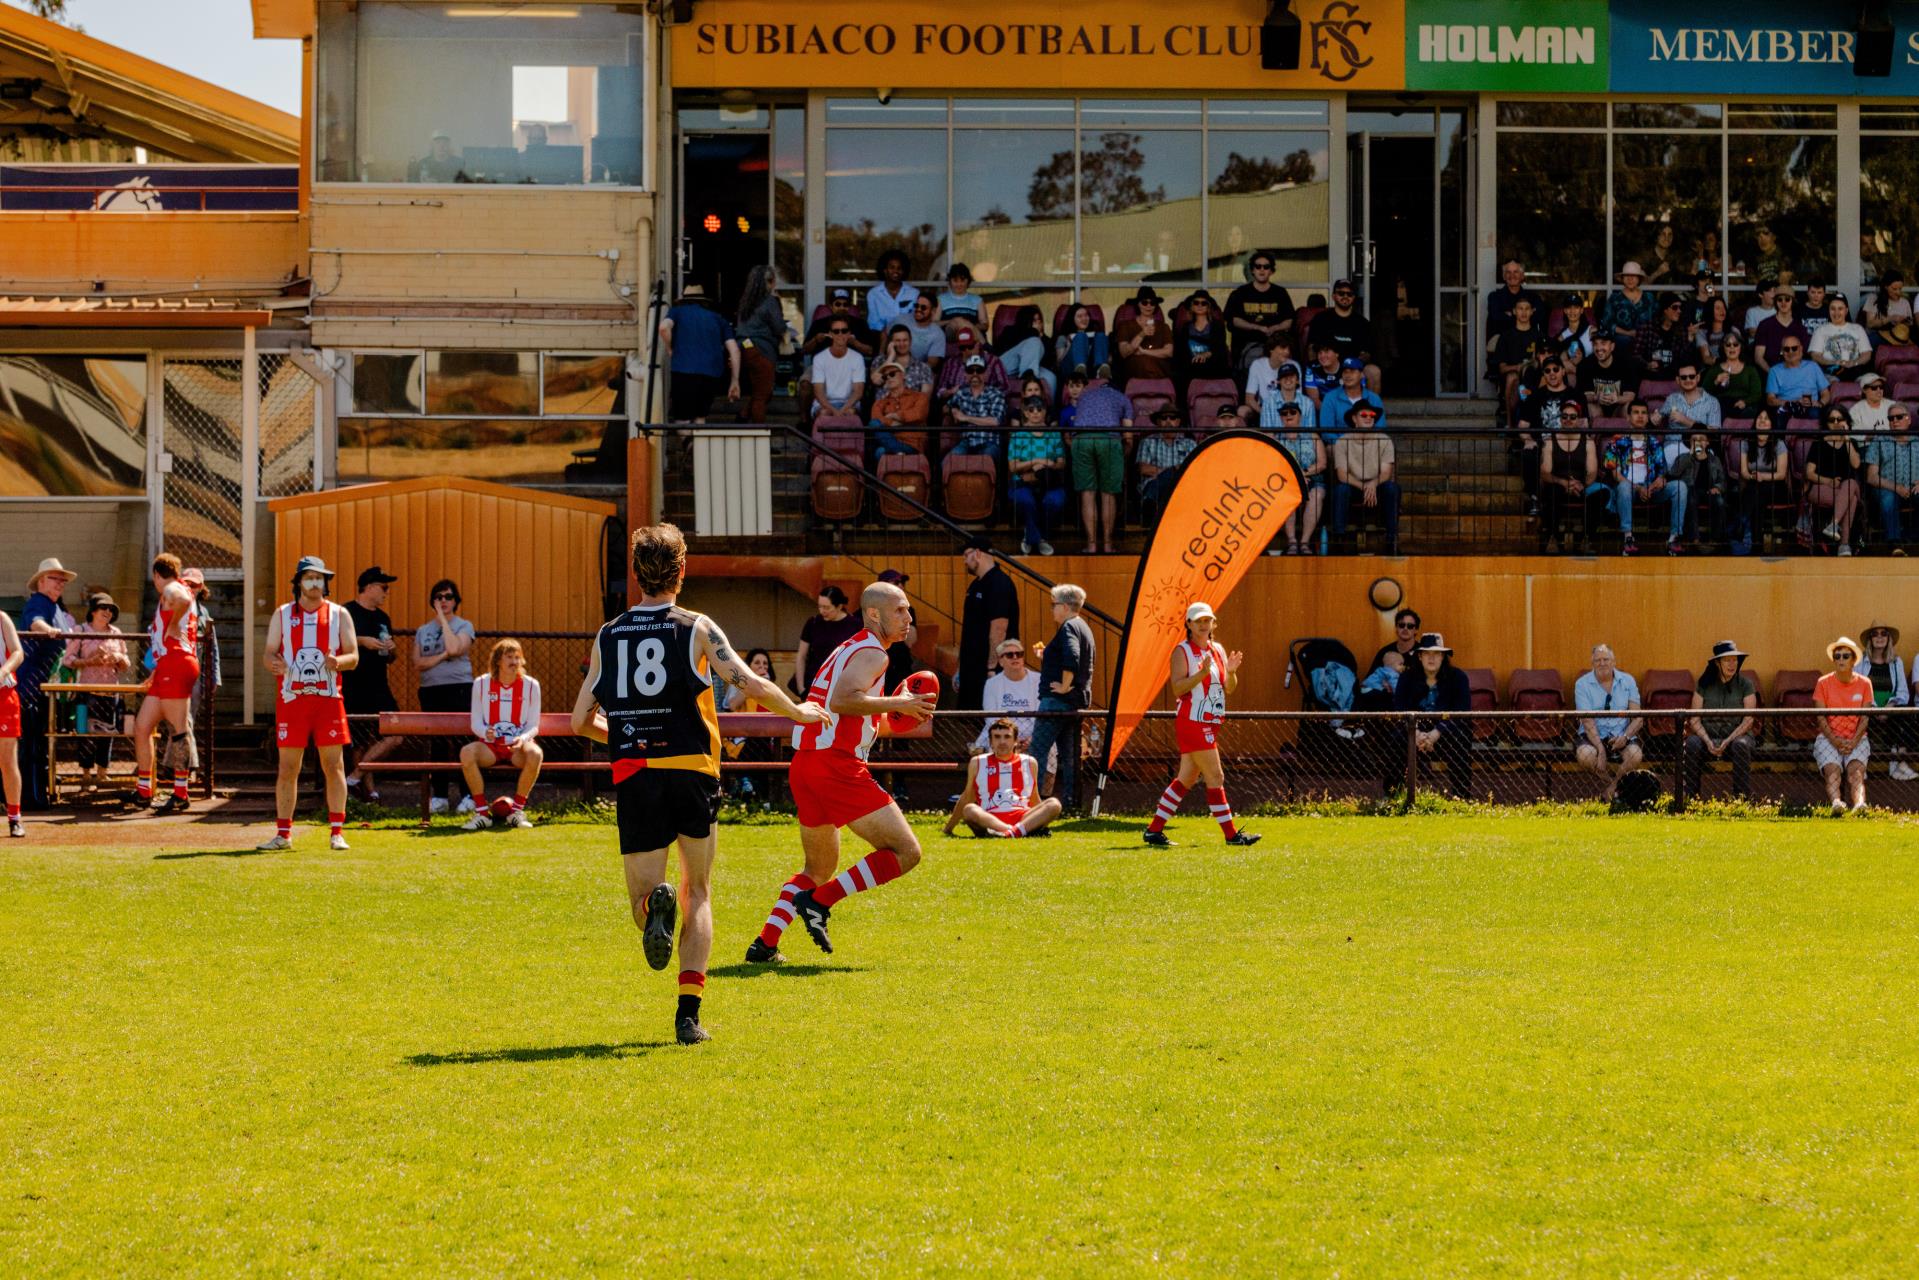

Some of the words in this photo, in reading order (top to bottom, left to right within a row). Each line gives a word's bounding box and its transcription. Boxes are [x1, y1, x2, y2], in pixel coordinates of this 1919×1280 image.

[697, 23, 896, 55] SUBIACO
[912, 24, 1156, 55] FOOTBALL
[1163, 25, 1263, 56] CLU
[1419, 24, 1596, 65] HOLMAN
[1648, 28, 1856, 64] MEMBER
[1181, 476, 1250, 569] reclink
[1203, 472, 1288, 582] australia
[616, 637, 667, 698] 18
